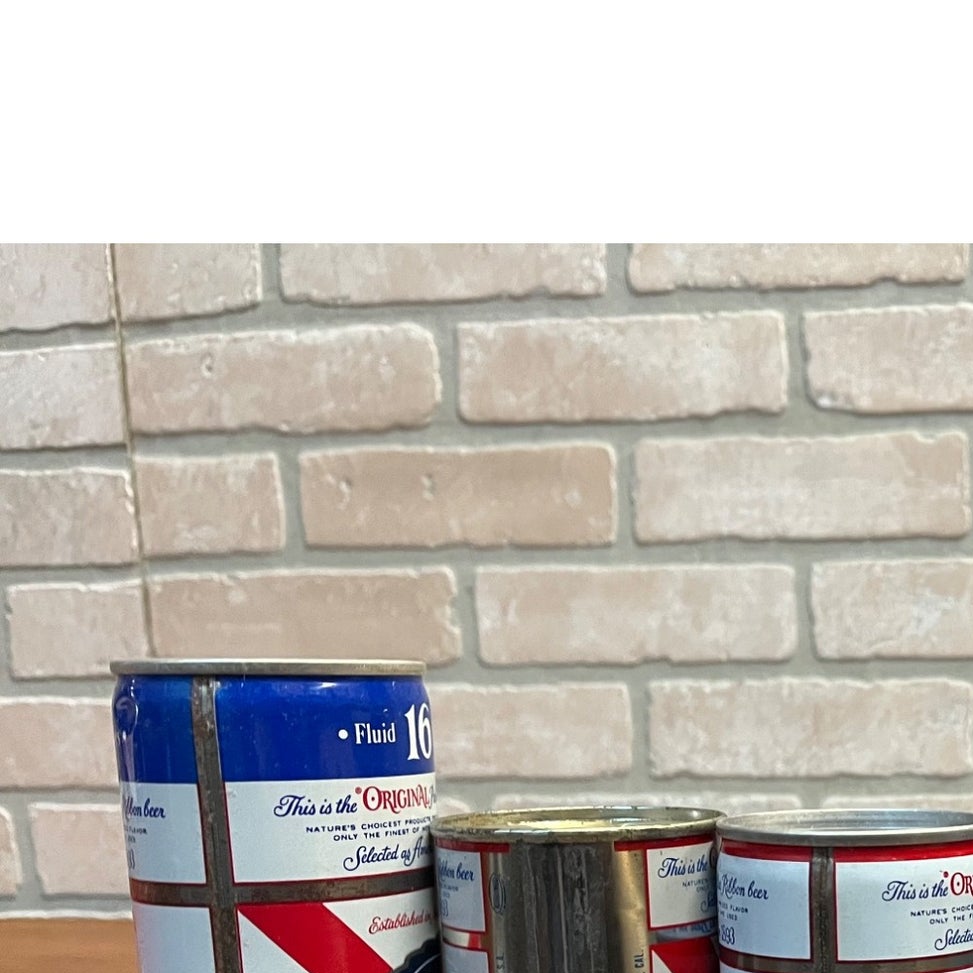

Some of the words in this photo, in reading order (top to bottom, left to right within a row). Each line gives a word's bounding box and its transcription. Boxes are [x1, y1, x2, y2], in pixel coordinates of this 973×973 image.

[355, 722, 396, 745] Fluid
[404, 702, 432, 761] 16
[274, 794, 316, 818] This
[319, 798, 332, 815] is
[335, 794, 358, 814] the
[306, 823, 356, 833] NATURE'S
[361, 820, 401, 831] CHOICEST
[333, 832, 358, 842] ONLY
[364, 831, 380, 840] THE
[385, 828, 409, 837] FINEST
[343, 843, 400, 871] Selected
[657, 857, 686, 879] This
[687, 859, 695, 874] is
[747, 880, 769, 900] beer
[881, 880, 917, 902] This
[919, 883, 929, 899] is
[931, 879, 949, 898] the
[368, 910, 423, 935] Established
[910, 908, 948, 917] NATURE'S
[929, 917, 948, 925] ONLY
[634, 950, 644, 968] CAL.
